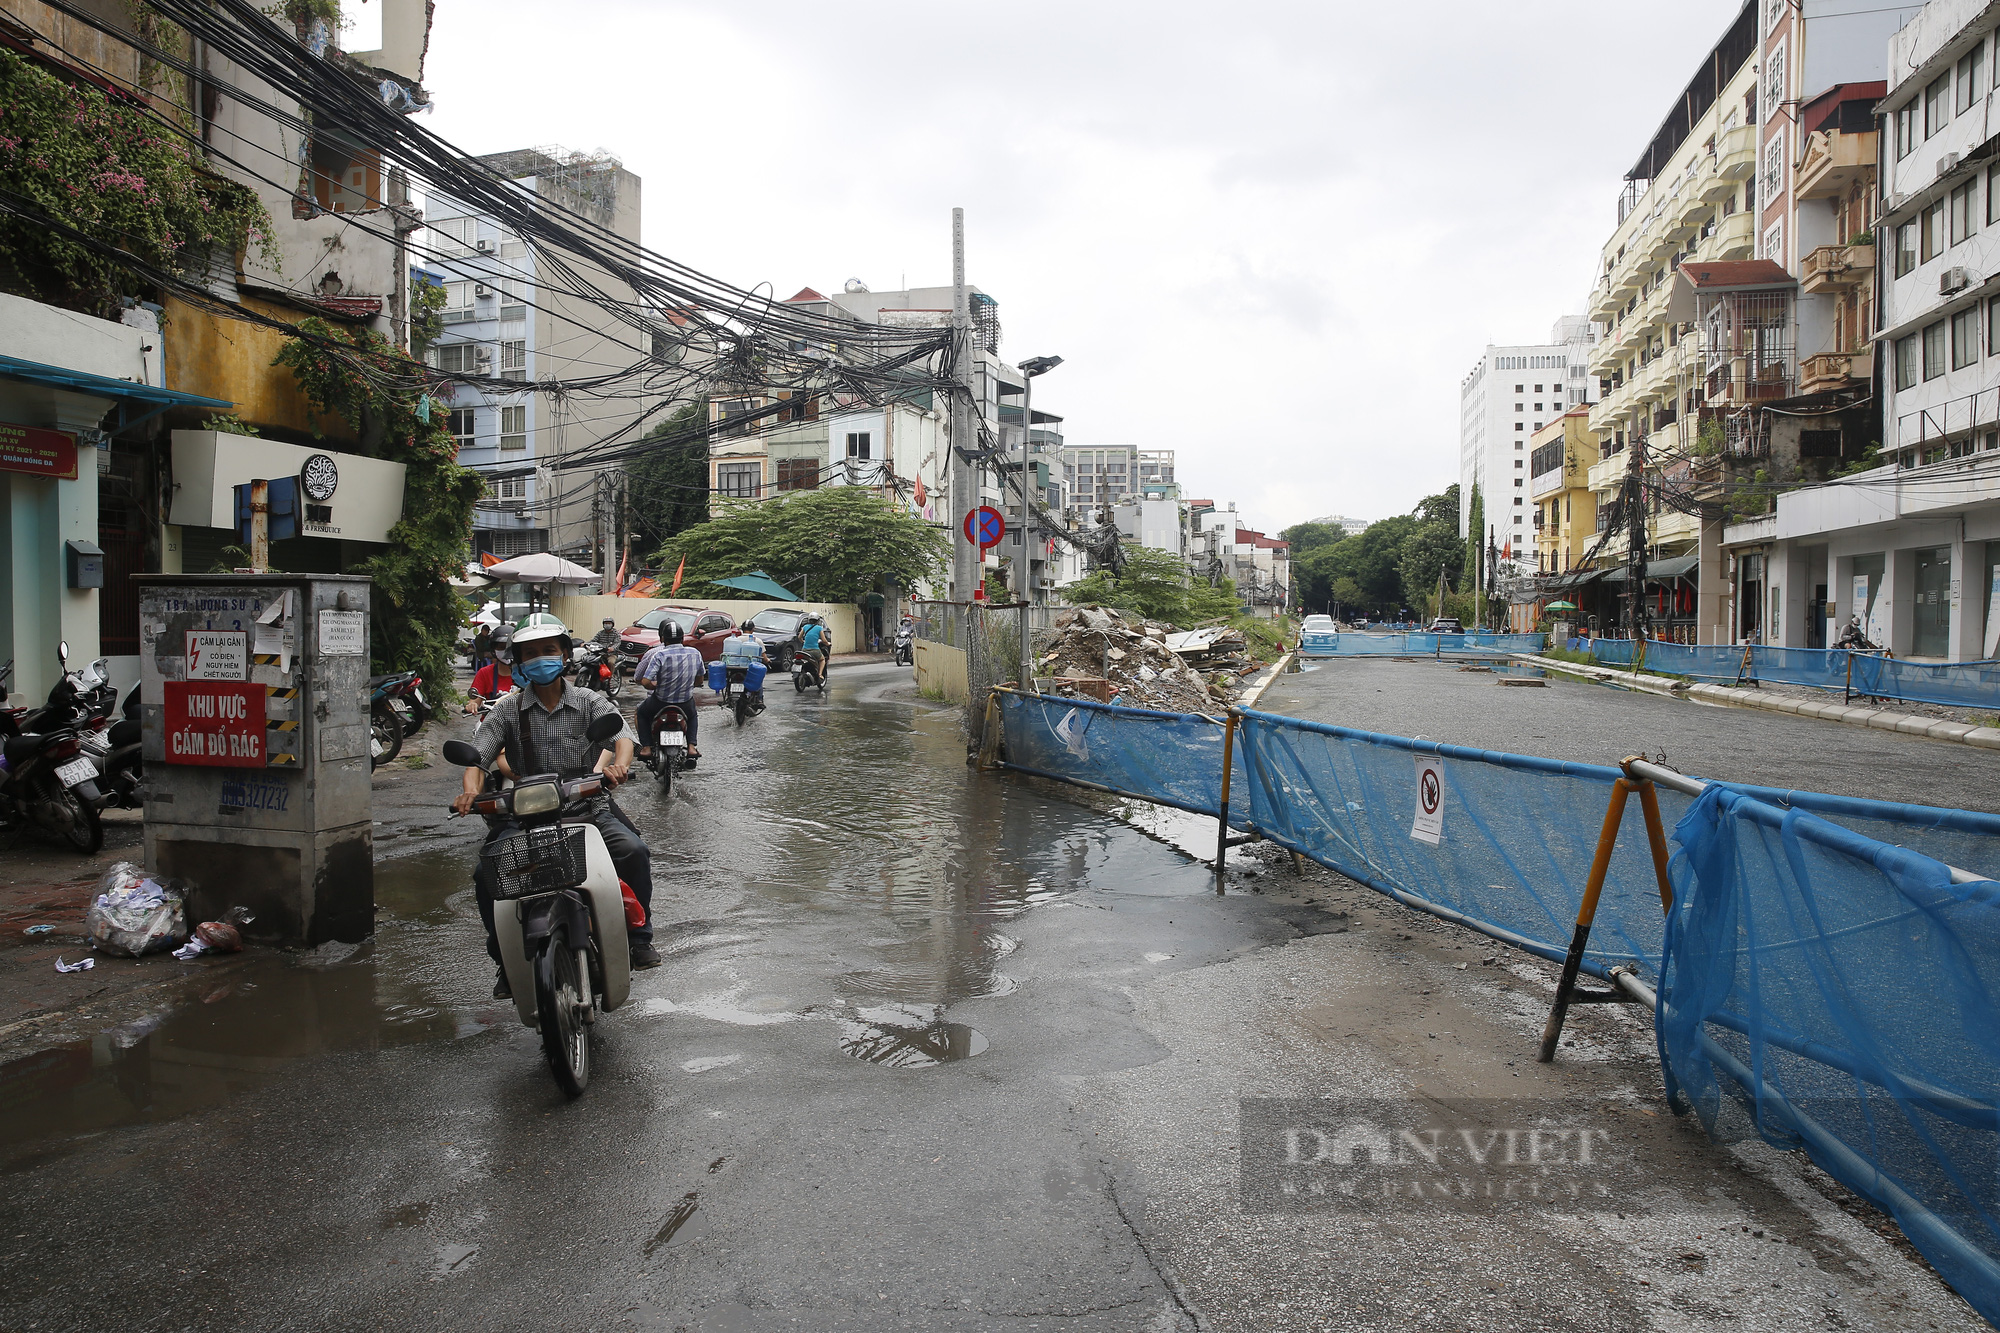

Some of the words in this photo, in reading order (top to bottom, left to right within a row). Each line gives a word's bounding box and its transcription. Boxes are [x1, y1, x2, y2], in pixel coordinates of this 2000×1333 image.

[16, 446, 33, 454] 2021
[3, 454, 23, 463] QUẬN
[168, 543, 177, 552] 23
[215, 637, 226, 648] LẠI
[210, 652, 219, 660] CÓ
[188, 694, 215, 718] KHU
[218, 693, 247, 724] VỰC
[172, 724, 205, 755] CẤM
[208, 724, 227, 757] ĐỔ
[229, 730, 259, 758] RÁC
